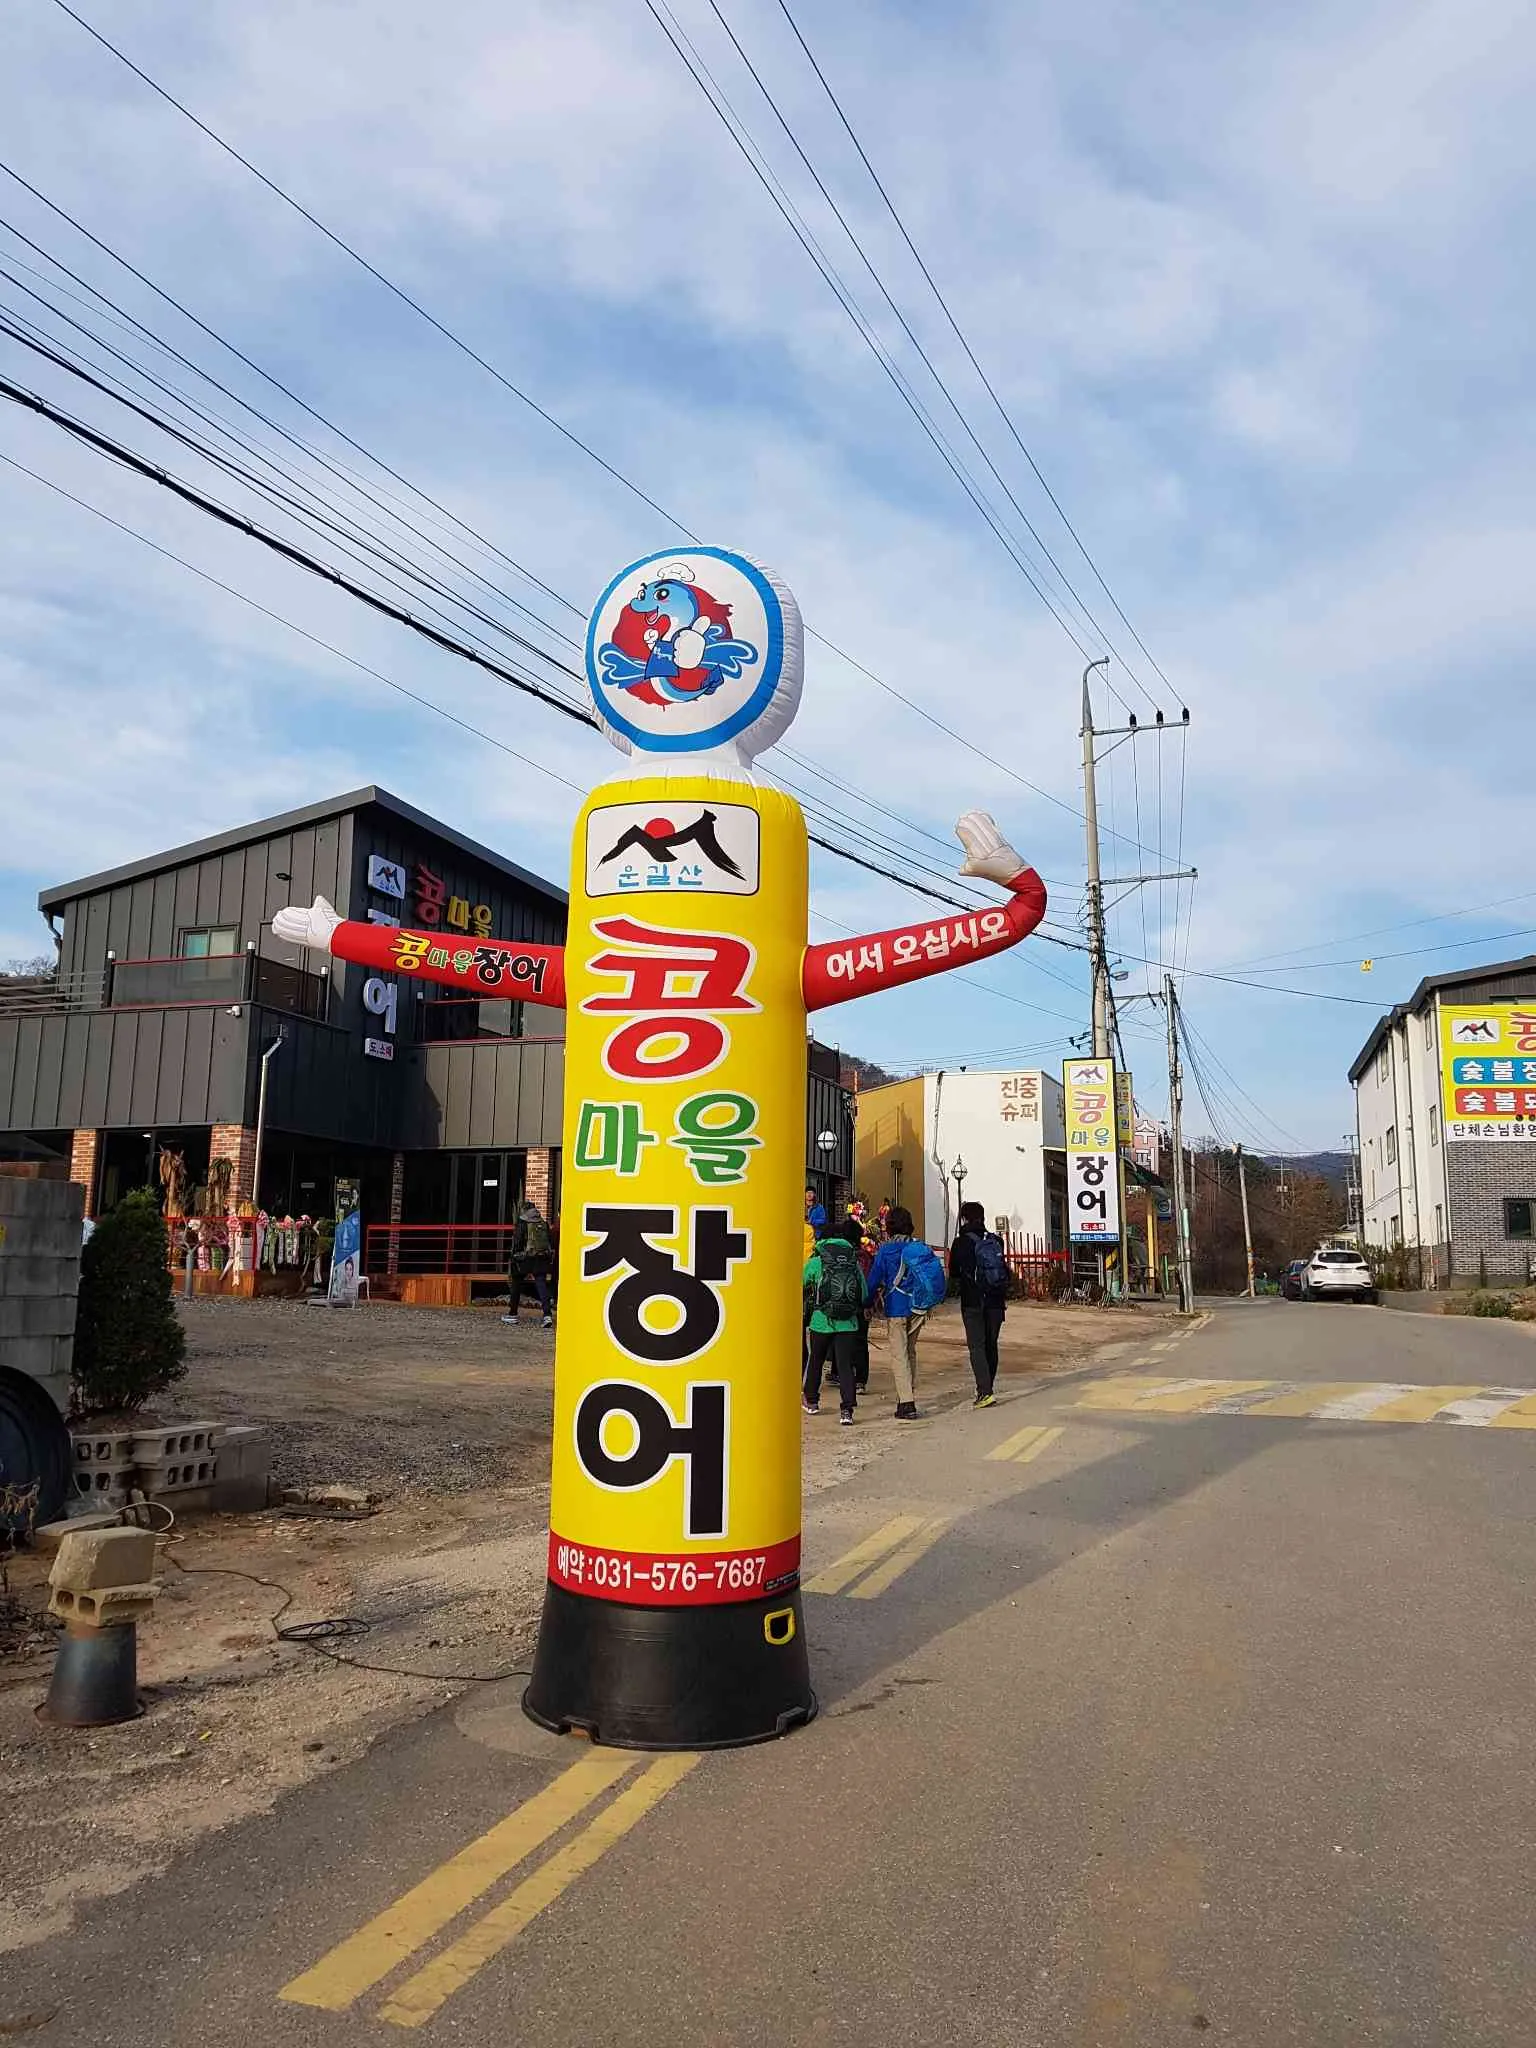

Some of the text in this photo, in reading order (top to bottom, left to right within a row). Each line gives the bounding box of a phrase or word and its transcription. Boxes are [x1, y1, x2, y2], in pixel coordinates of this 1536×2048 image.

[616, 863, 703, 888] 운길산
[826, 912, 1010, 980] 어서 오십시오
[580, 916, 761, 1081] 콩
[1000, 1102, 1038, 1121] 슈퍼
[1001, 1077, 1038, 1099] 진중
[575, 1092, 762, 1186] 마을
[1076, 1156, 1109, 1219] 장어
[575, 1206, 749, 1537] 장어
